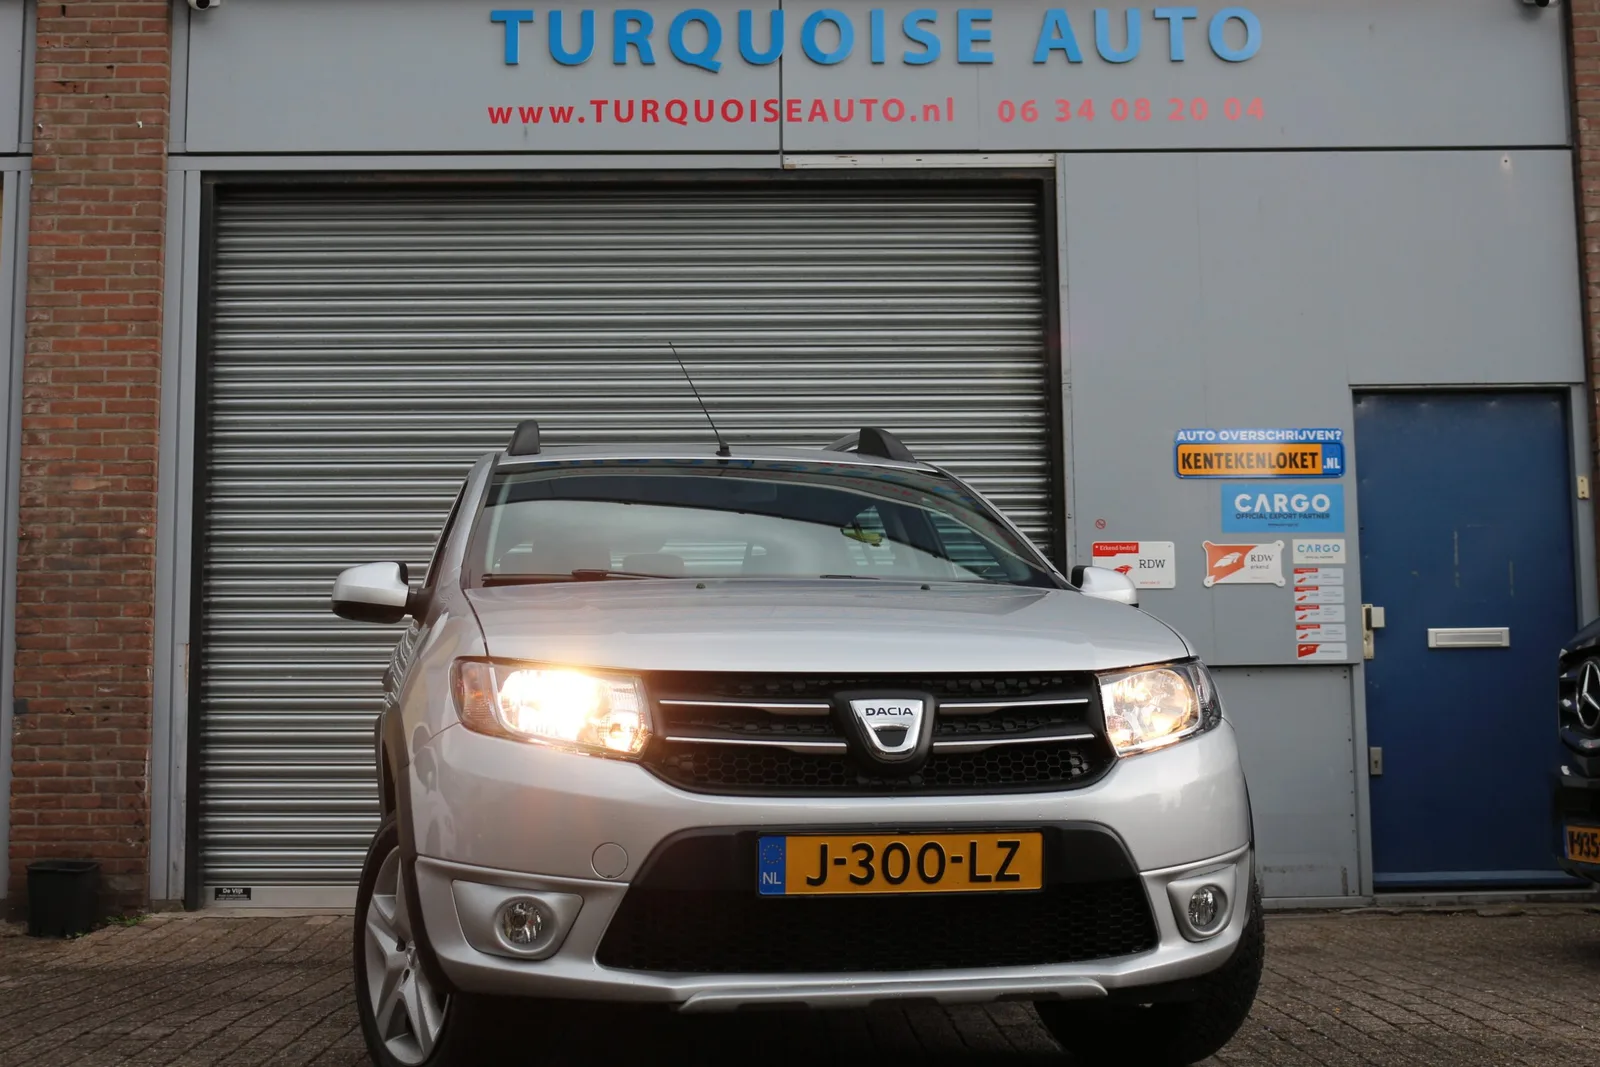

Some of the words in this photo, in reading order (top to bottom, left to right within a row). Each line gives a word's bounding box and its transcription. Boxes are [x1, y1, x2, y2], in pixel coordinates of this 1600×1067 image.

[490, 8, 994, 73] TURQUOISE
[1032, 7, 1263, 64] AUTO
[487, 97, 954, 126] www.TURQUOISEAUTO.nl
[997, 99, 1039, 123] 06
[1054, 98, 1096, 123] 34
[1110, 97, 1153, 122] 08
[1168, 97, 1209, 122] 20
[1223, 97, 1265, 121] 04
[1177, 431, 1216, 441] AUTO
[1219, 430, 1342, 441] OVERSCHRIJVEN?
[1182, 452, 1318, 470] KENTEKENLOKET
[1234, 493, 1331, 513] CARGO
[1297, 544, 1341, 553] CARGO
[1139, 559, 1165, 569] RDW
[1250, 554, 1274, 562] RDW
[865, 707, 913, 716] DACIA
[806, 840, 1021, 886] J-300-LZ
[762, 871, 781, 885] NL
